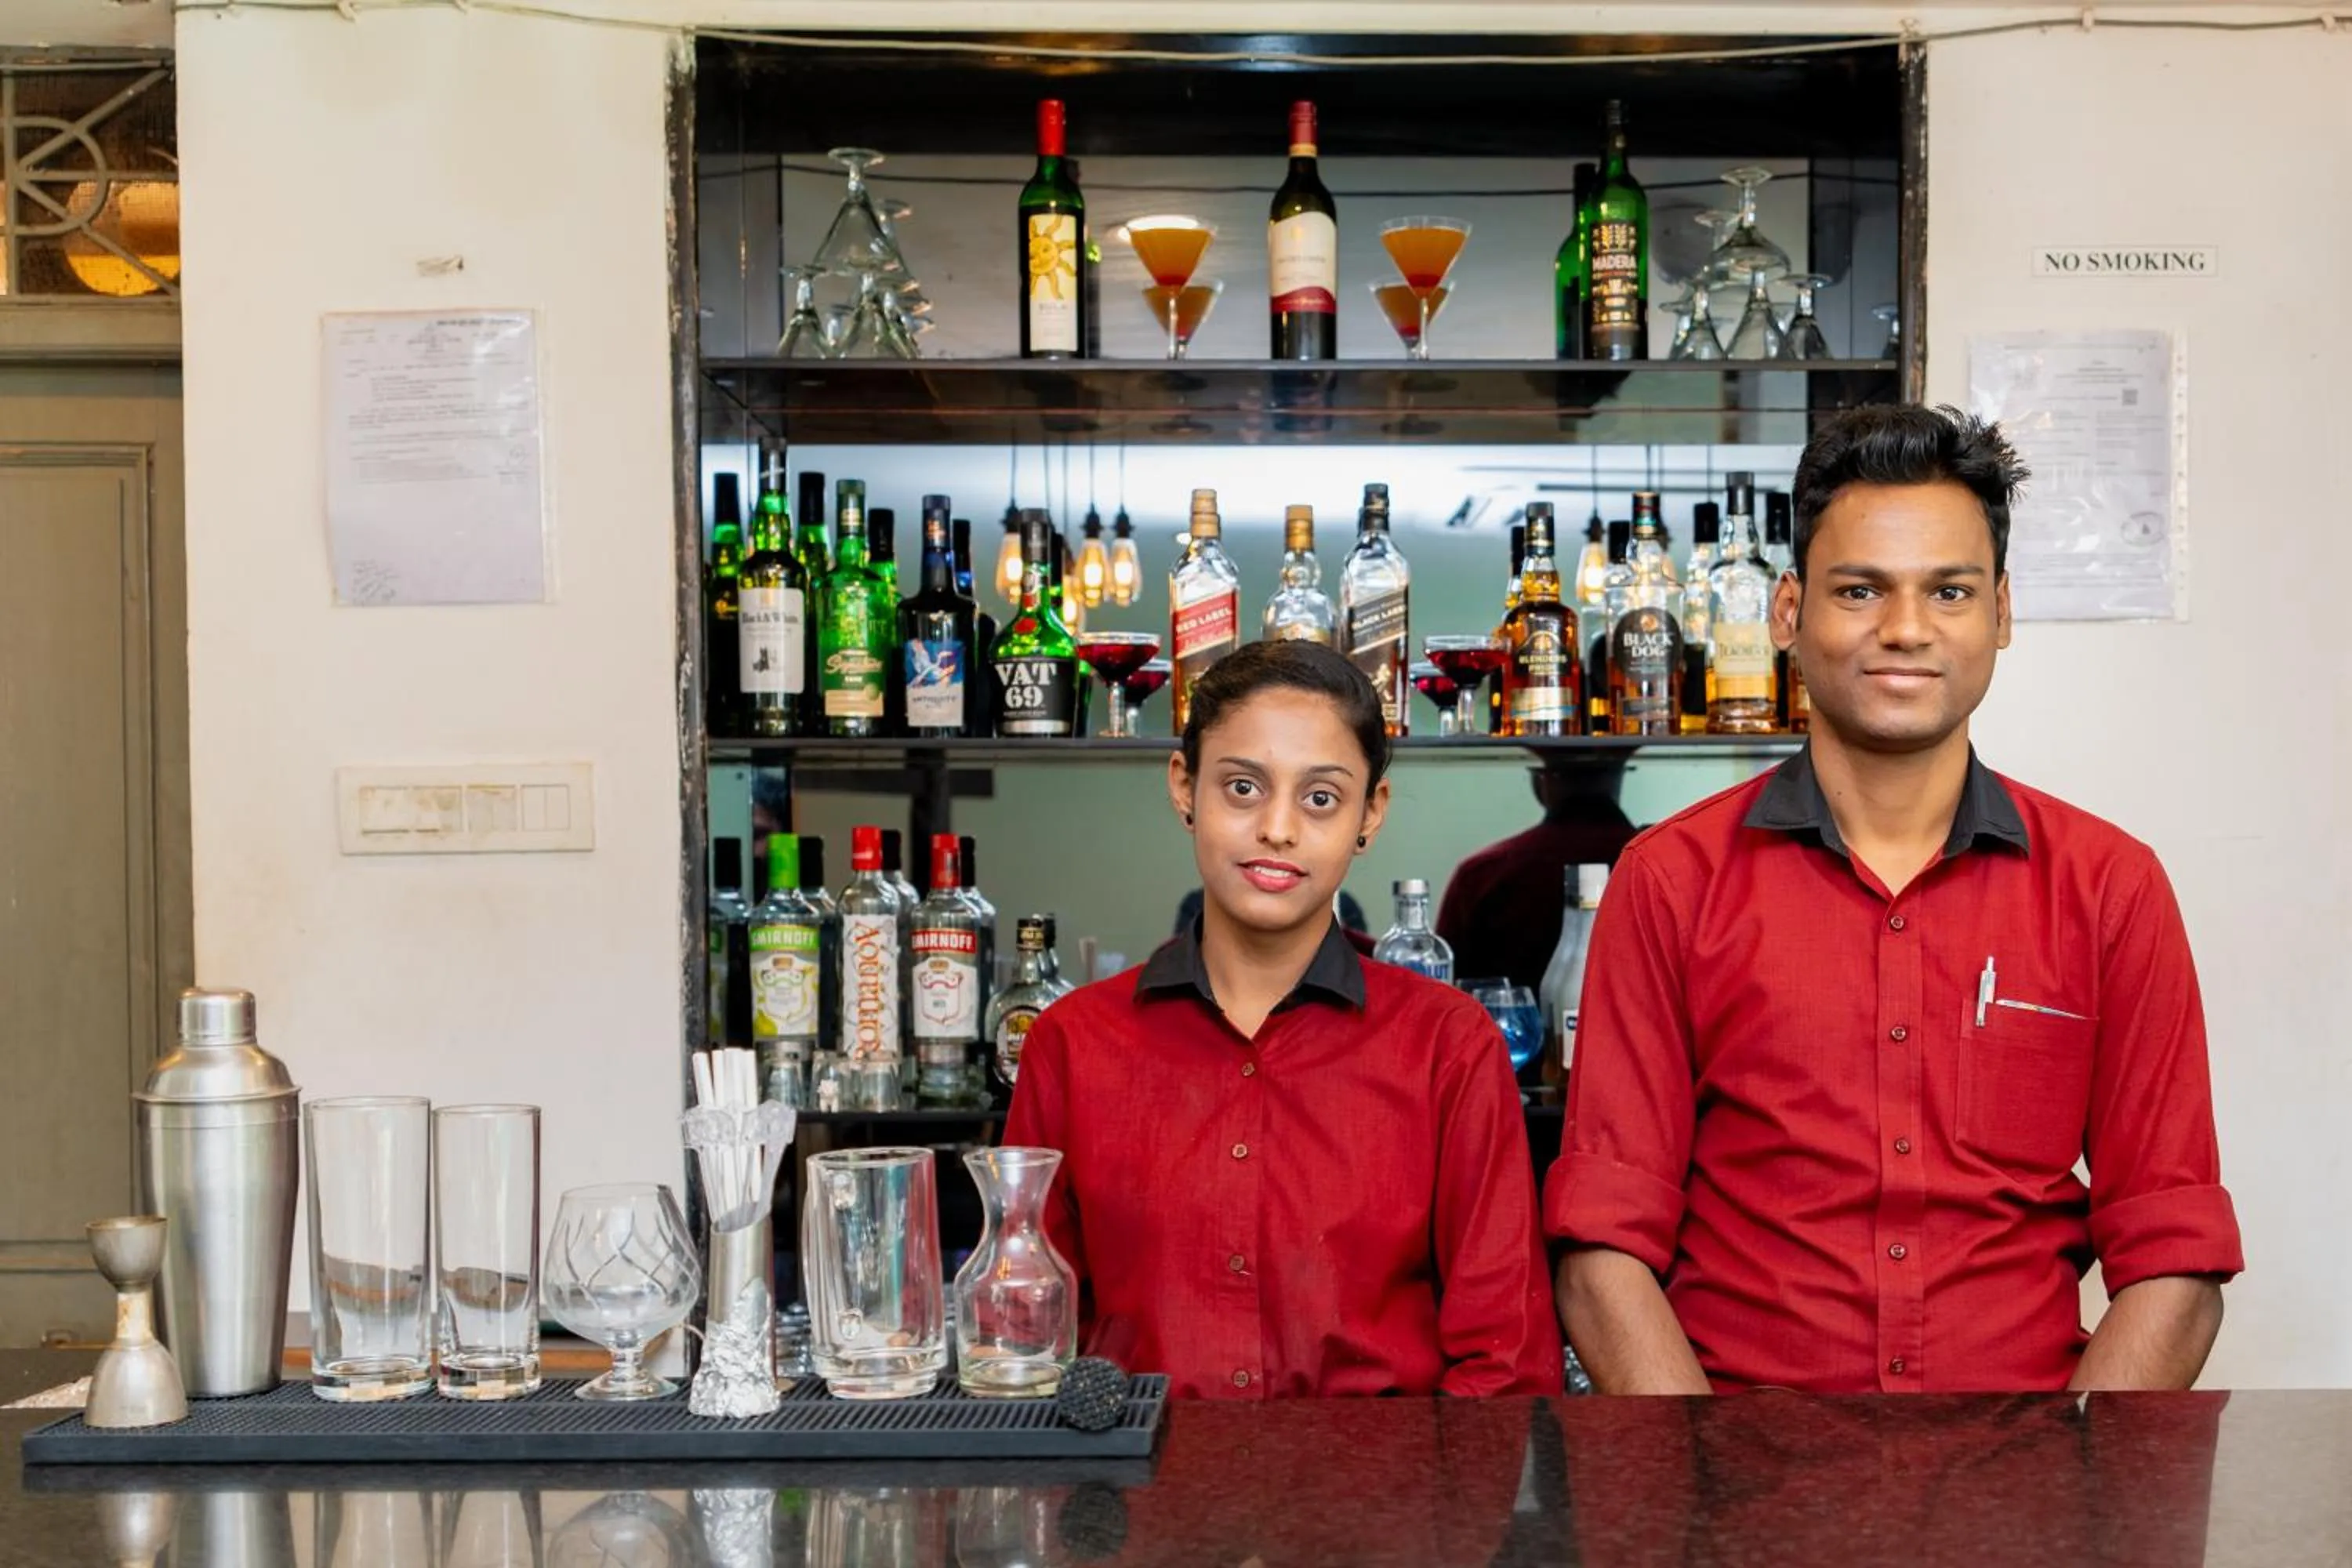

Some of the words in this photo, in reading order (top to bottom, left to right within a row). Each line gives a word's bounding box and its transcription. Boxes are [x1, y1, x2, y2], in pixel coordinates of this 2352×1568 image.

[1592, 254, 1637, 271] MADERA
[2045, 251, 2080, 272] NO
[2086, 251, 2205, 272] SMOKING
[1198, 606, 1232, 626] LABEL
[1623, 632, 1674, 647] BLACK
[1631, 645, 1668, 658] DOG
[994, 662, 1058, 686] VAT
[1004, 685, 1044, 709] 69
